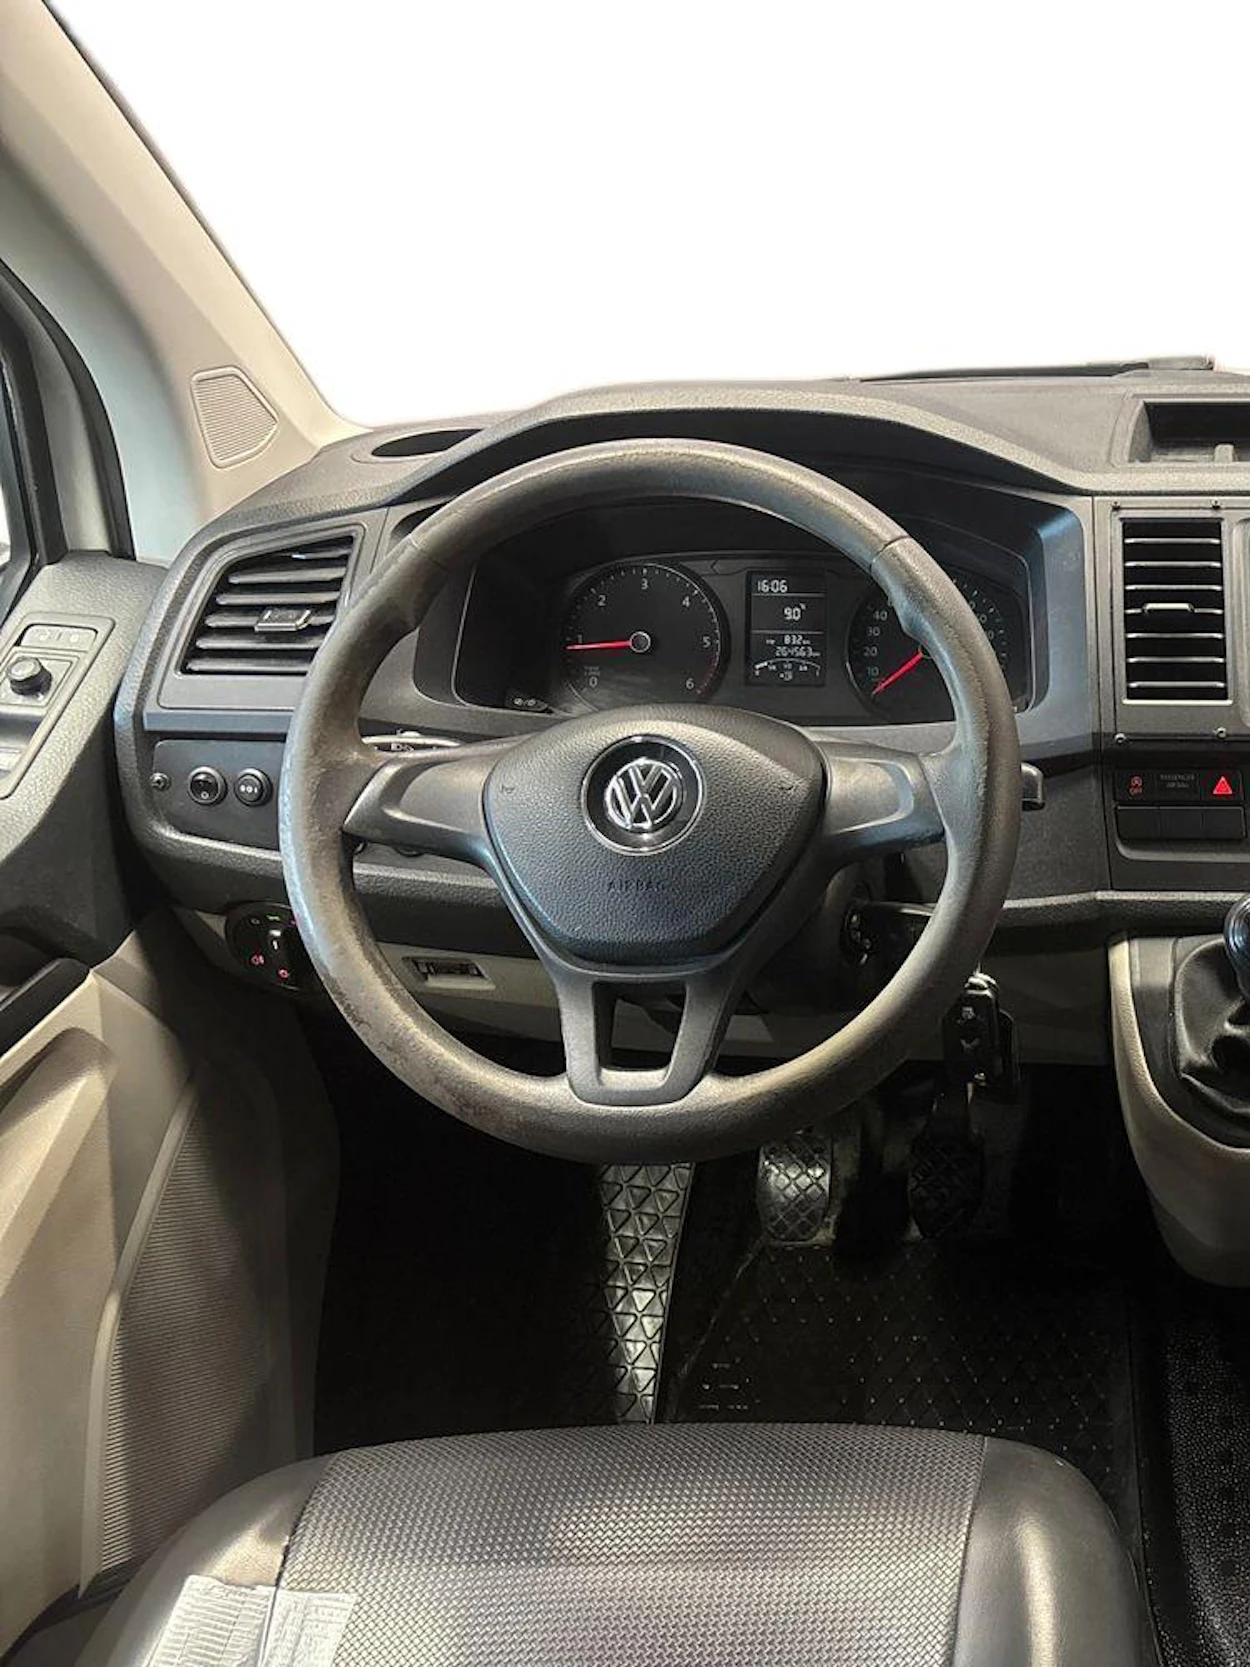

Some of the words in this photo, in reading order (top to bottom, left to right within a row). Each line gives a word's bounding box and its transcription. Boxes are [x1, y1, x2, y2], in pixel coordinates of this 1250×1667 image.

[640, 579, 649, 590] 3
[599, 595, 607, 607] 2
[682, 597, 691, 608] 4
[872, 610, 889, 622] 40
[867, 626, 881, 637] 30
[702, 636, 711, 648] 5
[784, 634, 804, 645] 832
[863, 646, 878, 657] 20
[867, 666, 880, 677] 10
[588, 677, 598, 688] 0
[685, 677, 695, 690] 6
